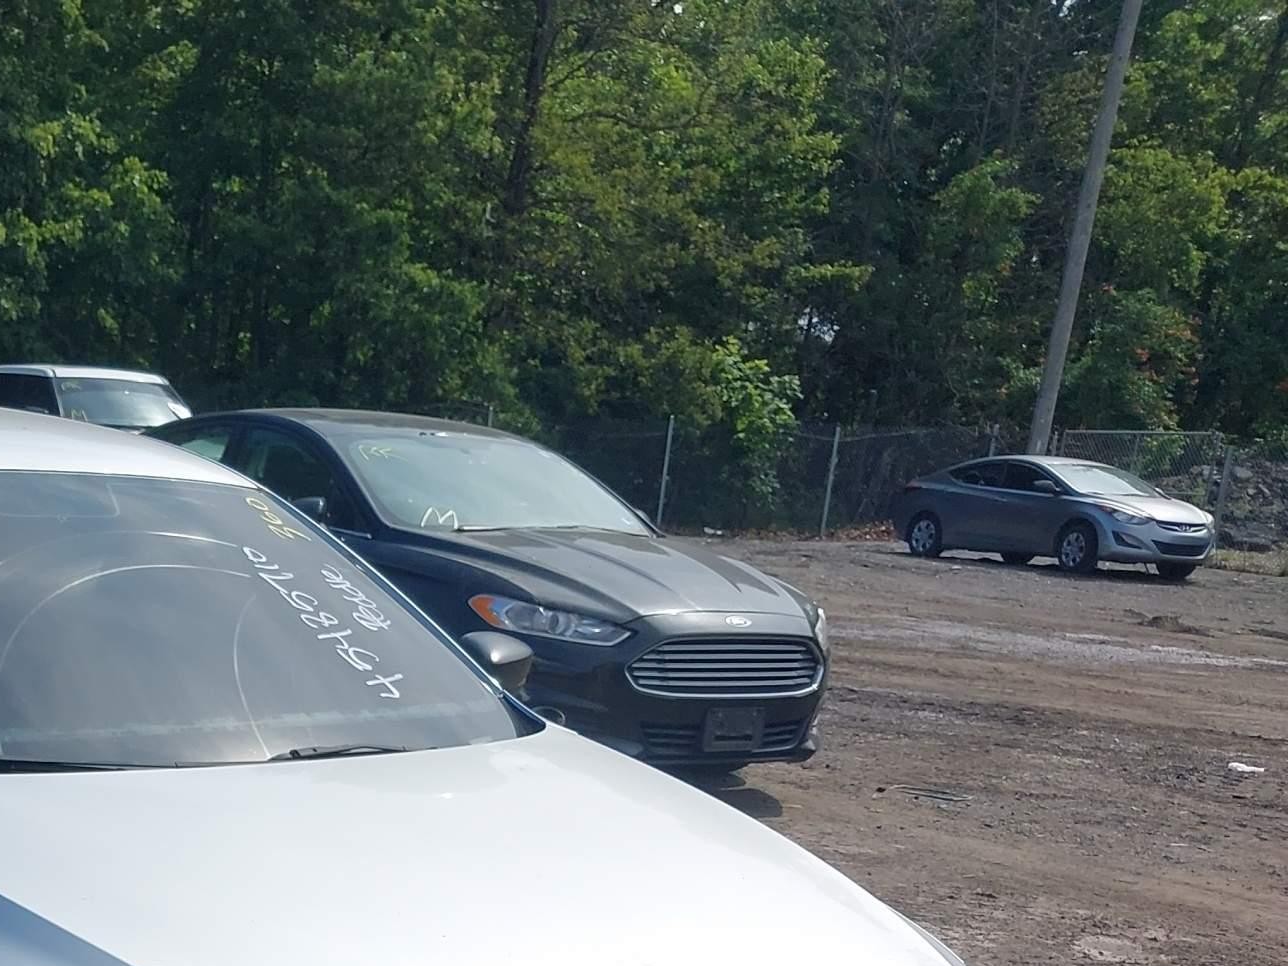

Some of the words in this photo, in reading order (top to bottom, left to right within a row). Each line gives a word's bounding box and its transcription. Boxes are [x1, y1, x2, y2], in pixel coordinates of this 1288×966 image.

[245, 497, 312, 541] 360
[420, 506, 459, 530] M
[242, 546, 403, 699] 45485710
